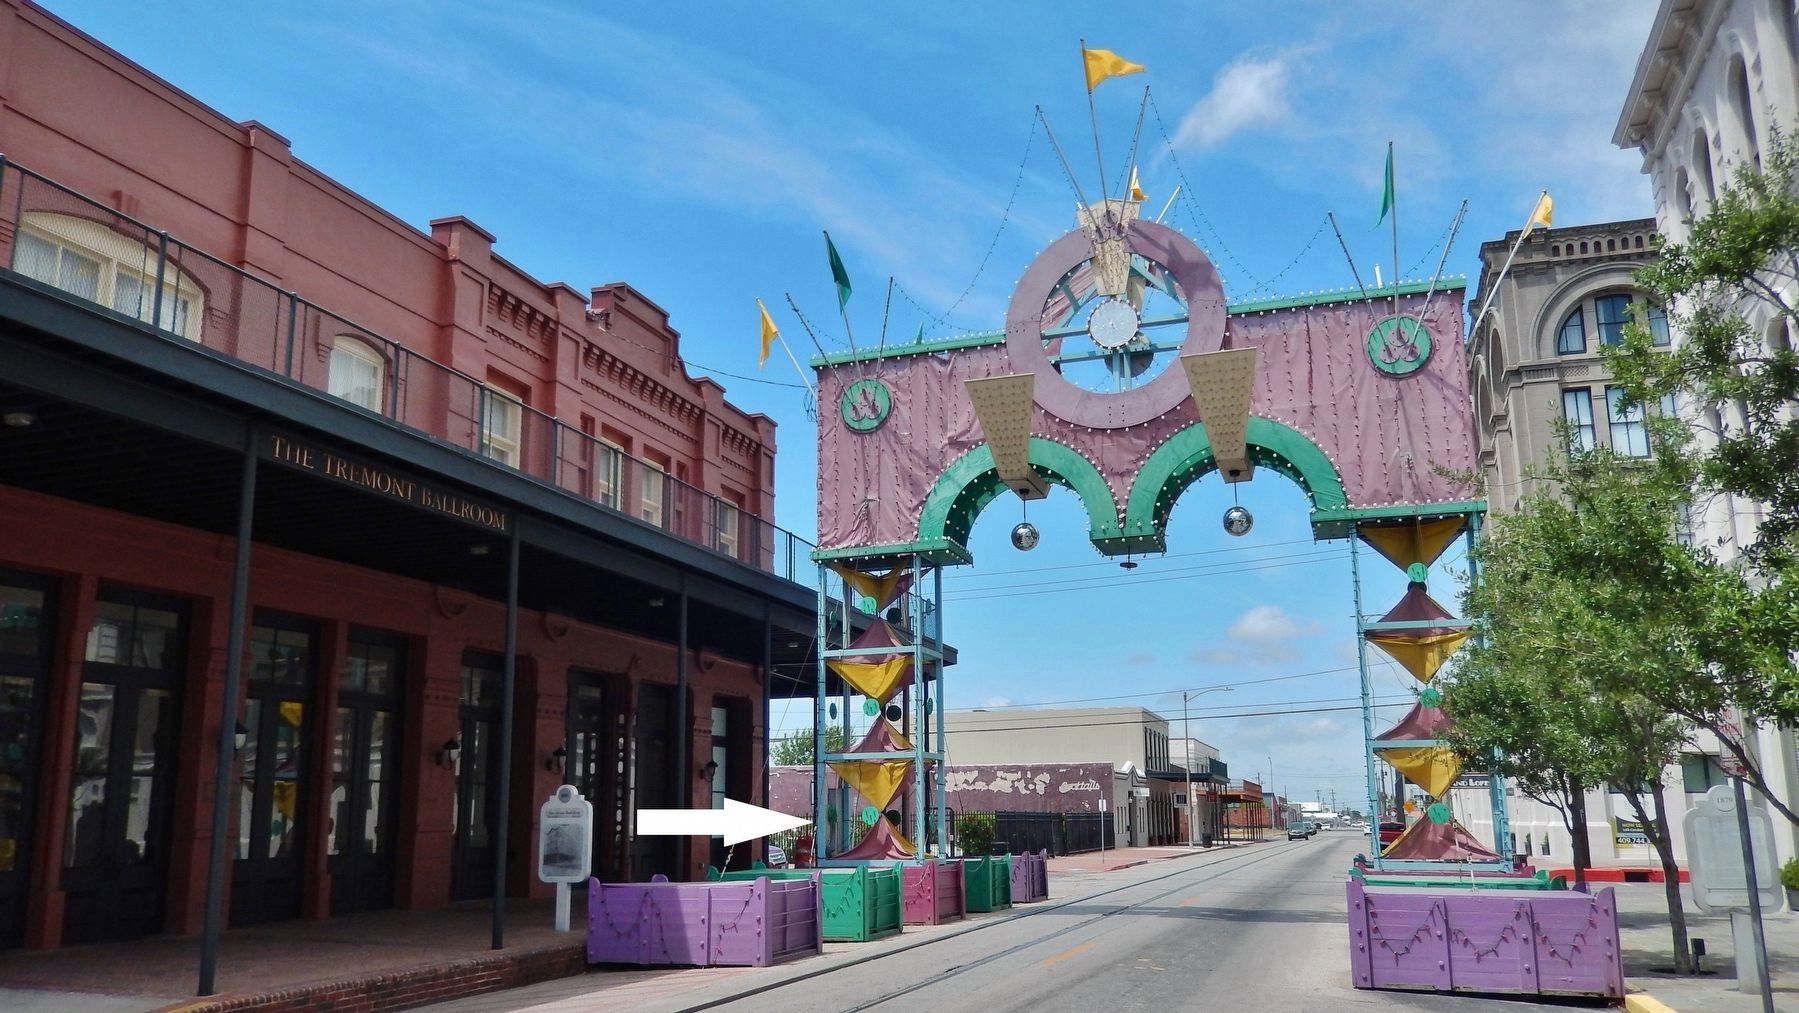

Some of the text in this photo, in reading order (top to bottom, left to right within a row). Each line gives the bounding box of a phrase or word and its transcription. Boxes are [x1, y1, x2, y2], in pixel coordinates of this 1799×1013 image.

[272, 435, 505, 530] THE TREMONT BALLROOM
